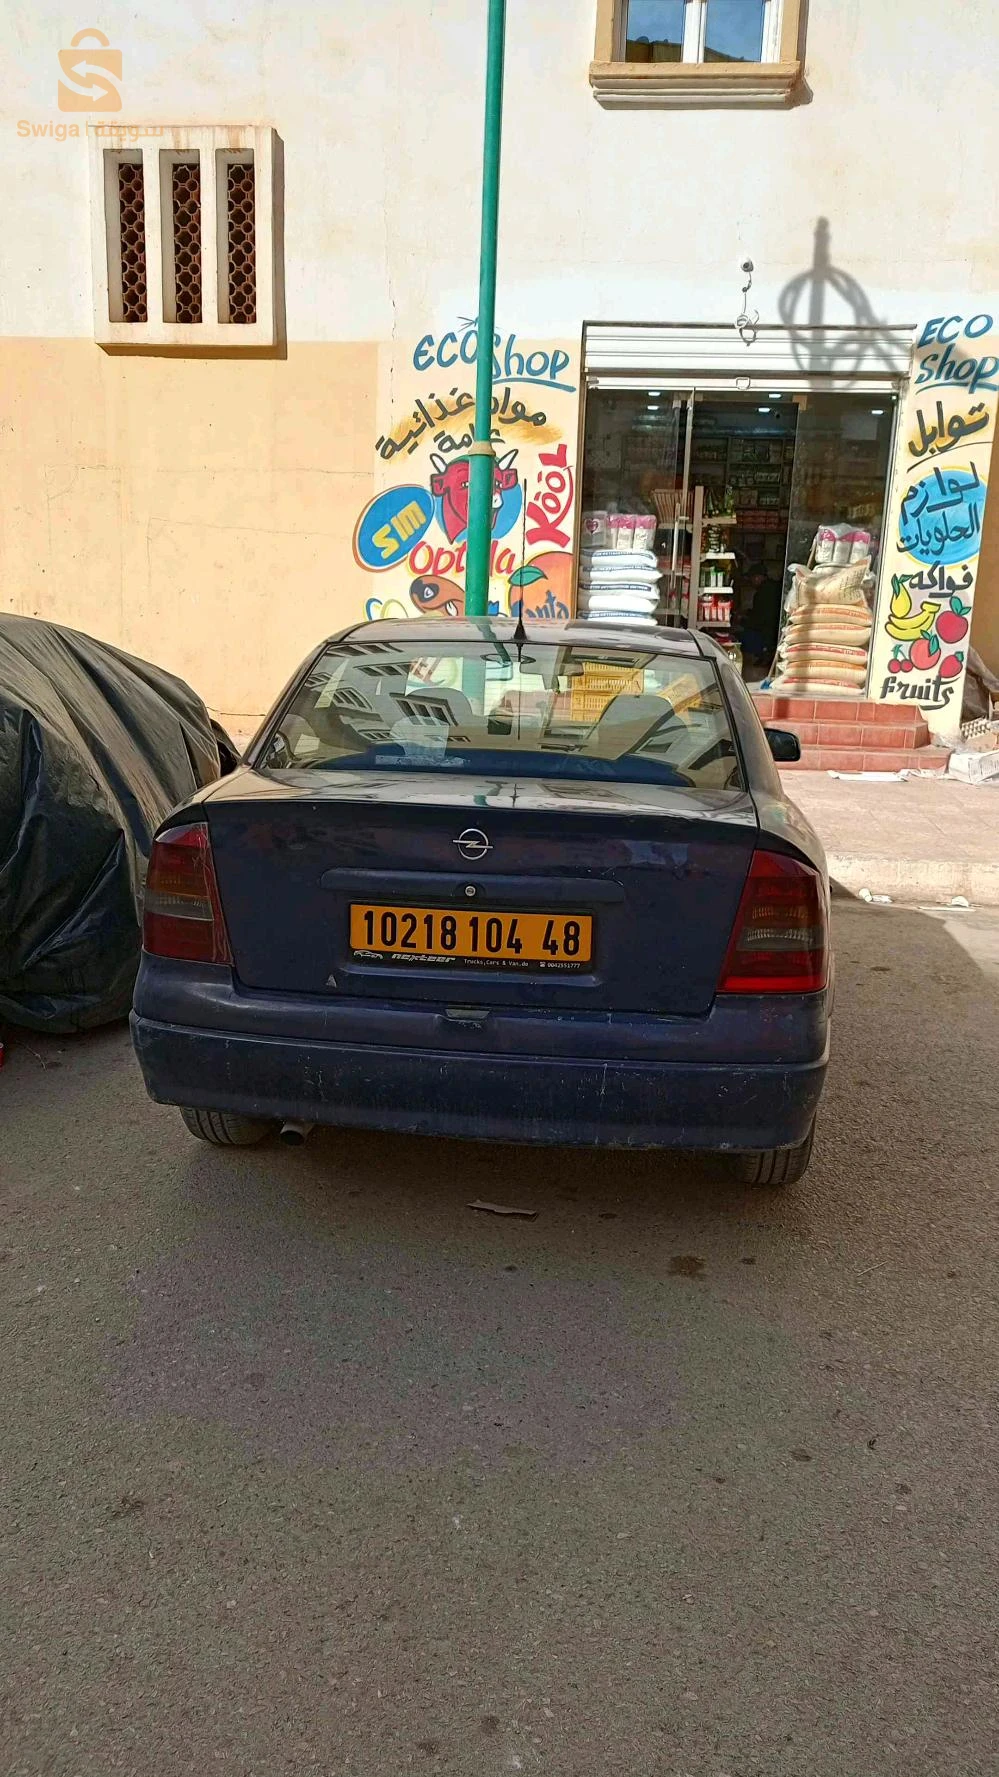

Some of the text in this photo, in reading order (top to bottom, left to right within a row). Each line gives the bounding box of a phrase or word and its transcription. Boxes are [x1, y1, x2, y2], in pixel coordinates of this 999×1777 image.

[412, 329, 478, 371] ECO
[917, 313, 993, 349] ECO
[908, 400, 990, 458] توابل
[900, 460, 981, 526] لوازم
[895, 502, 981, 556] الحلويات
[908, 559, 974, 599] فواكه
[363, 910, 581, 956] 10218 104 48
